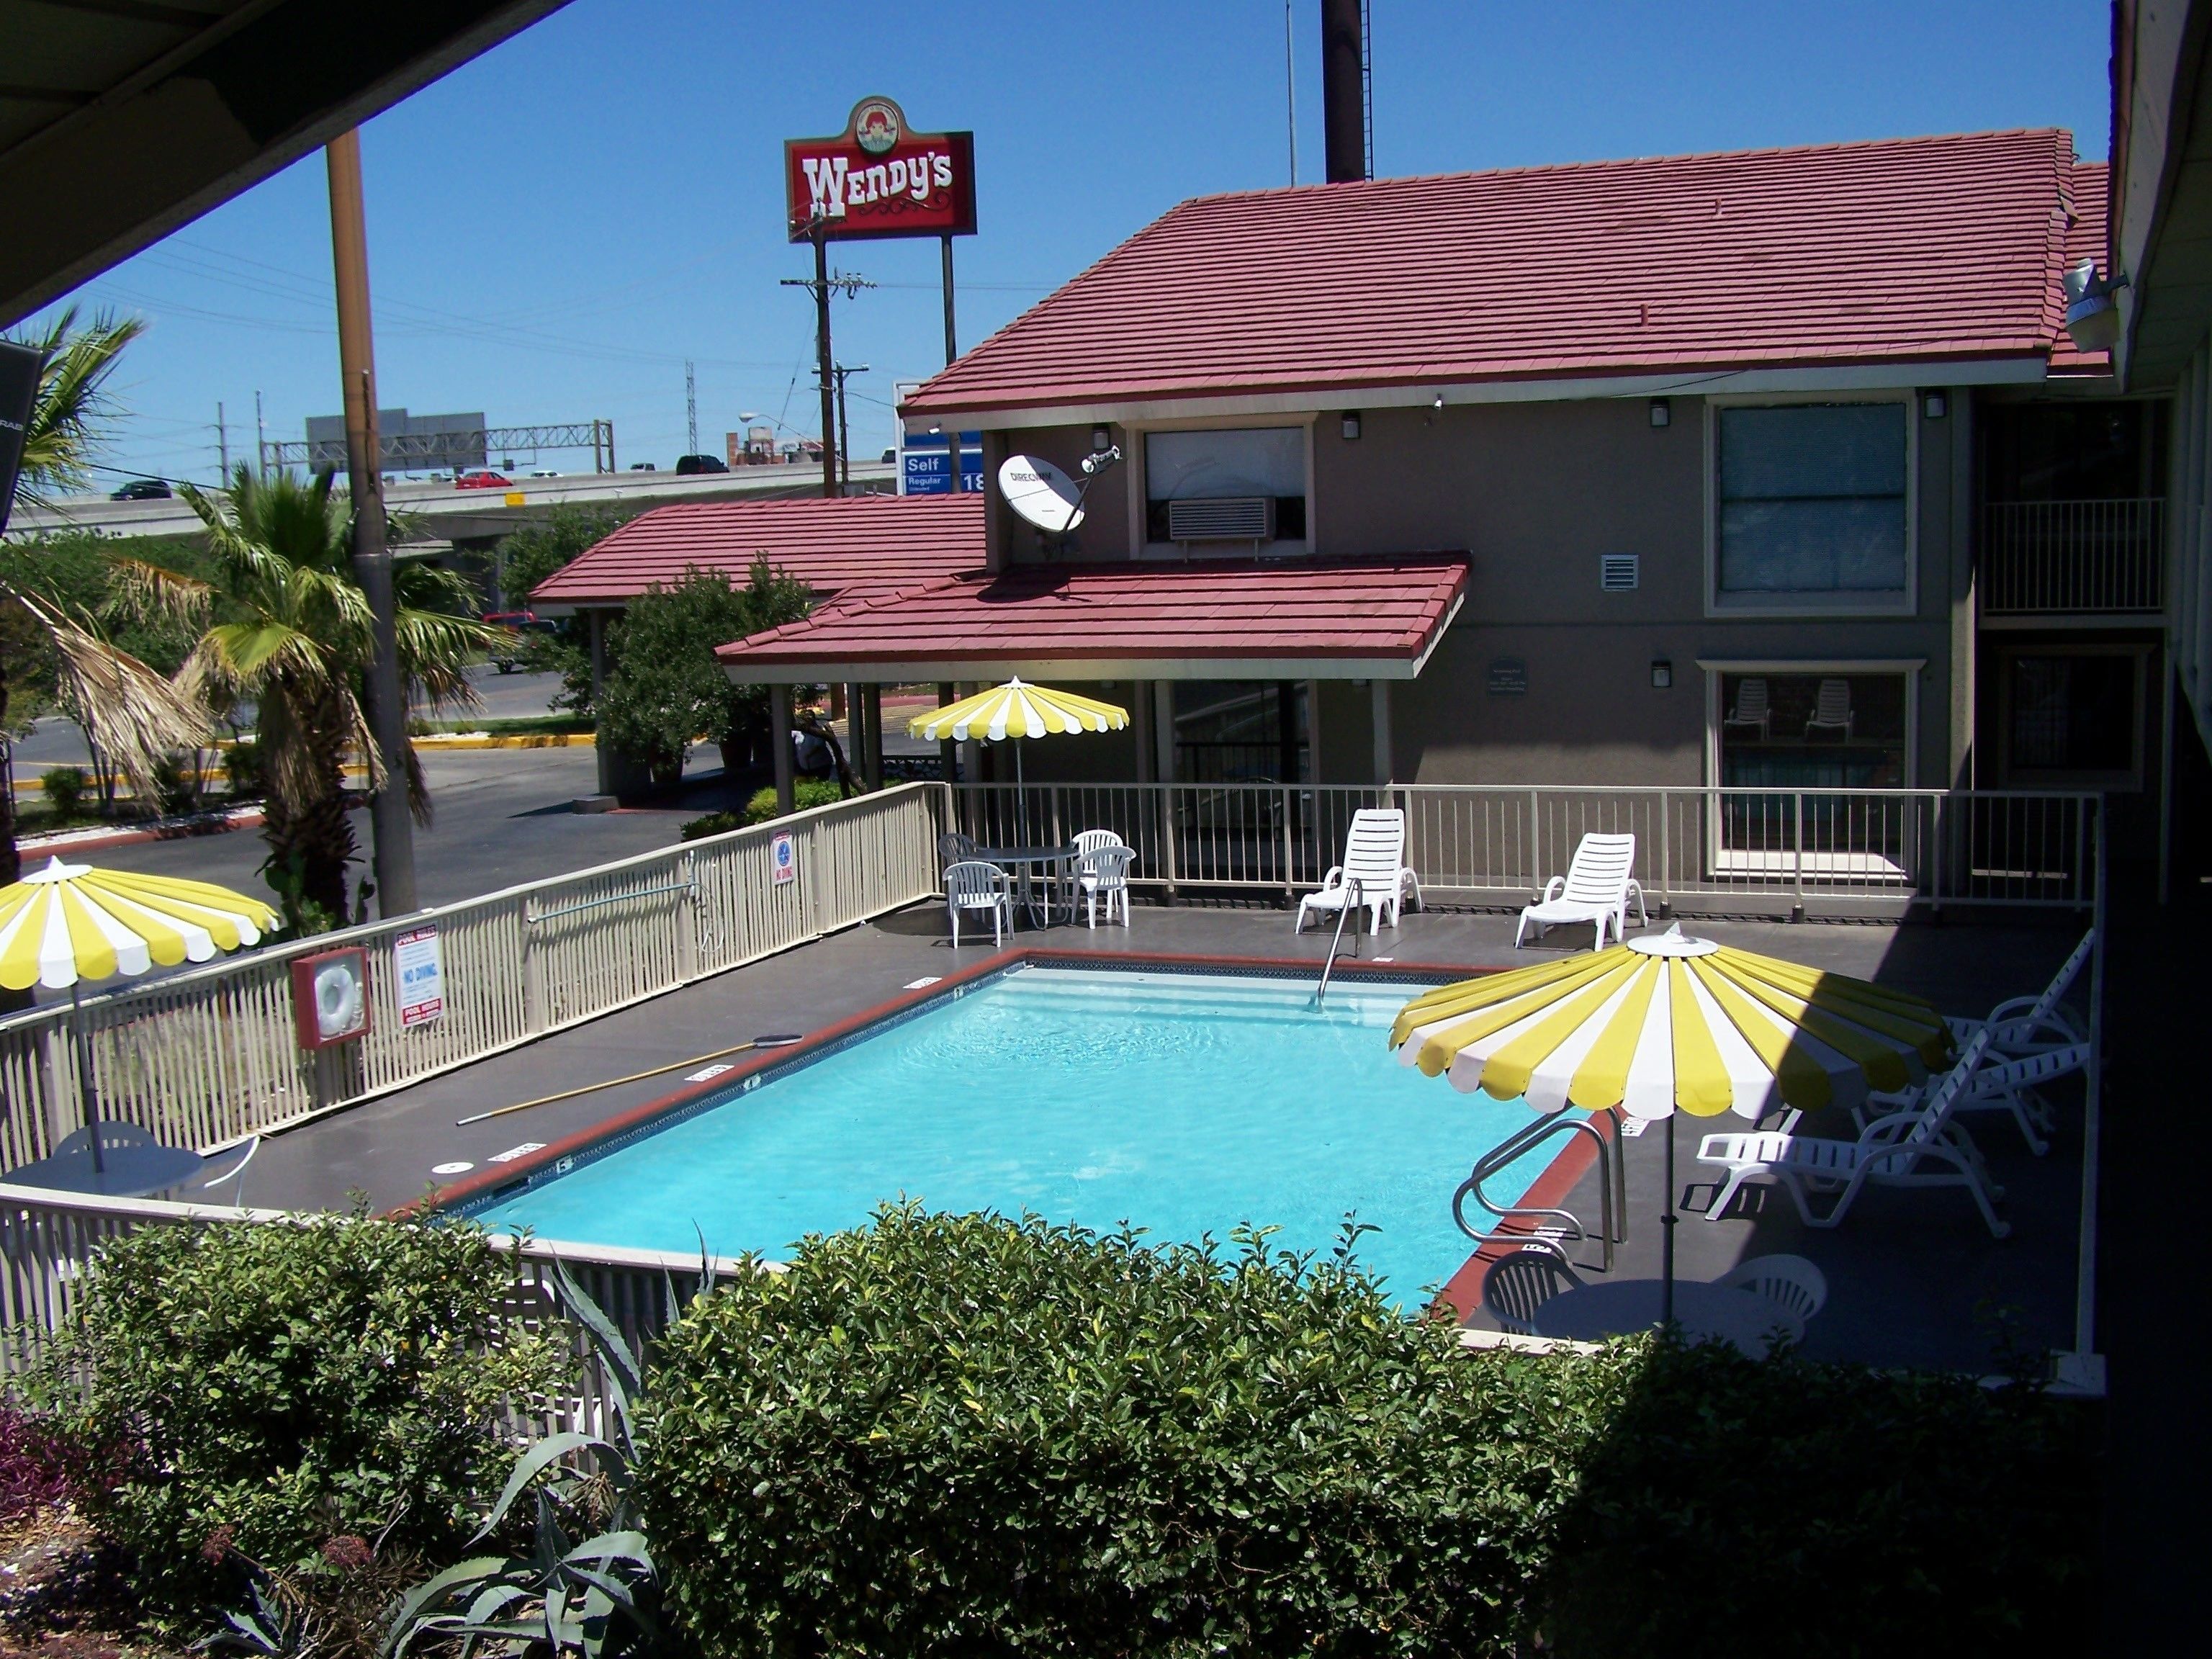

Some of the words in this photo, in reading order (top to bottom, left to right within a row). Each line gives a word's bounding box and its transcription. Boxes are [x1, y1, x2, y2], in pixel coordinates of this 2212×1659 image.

[801, 150, 953, 218] Wendy's
[908, 458, 939, 472] Self
[909, 476, 941, 486] Regular
[398, 932, 415, 945] POOL
[417, 926, 436, 940] RULES
[404, 968, 413, 984] NO
[415, 963, 437, 981] DIVING
